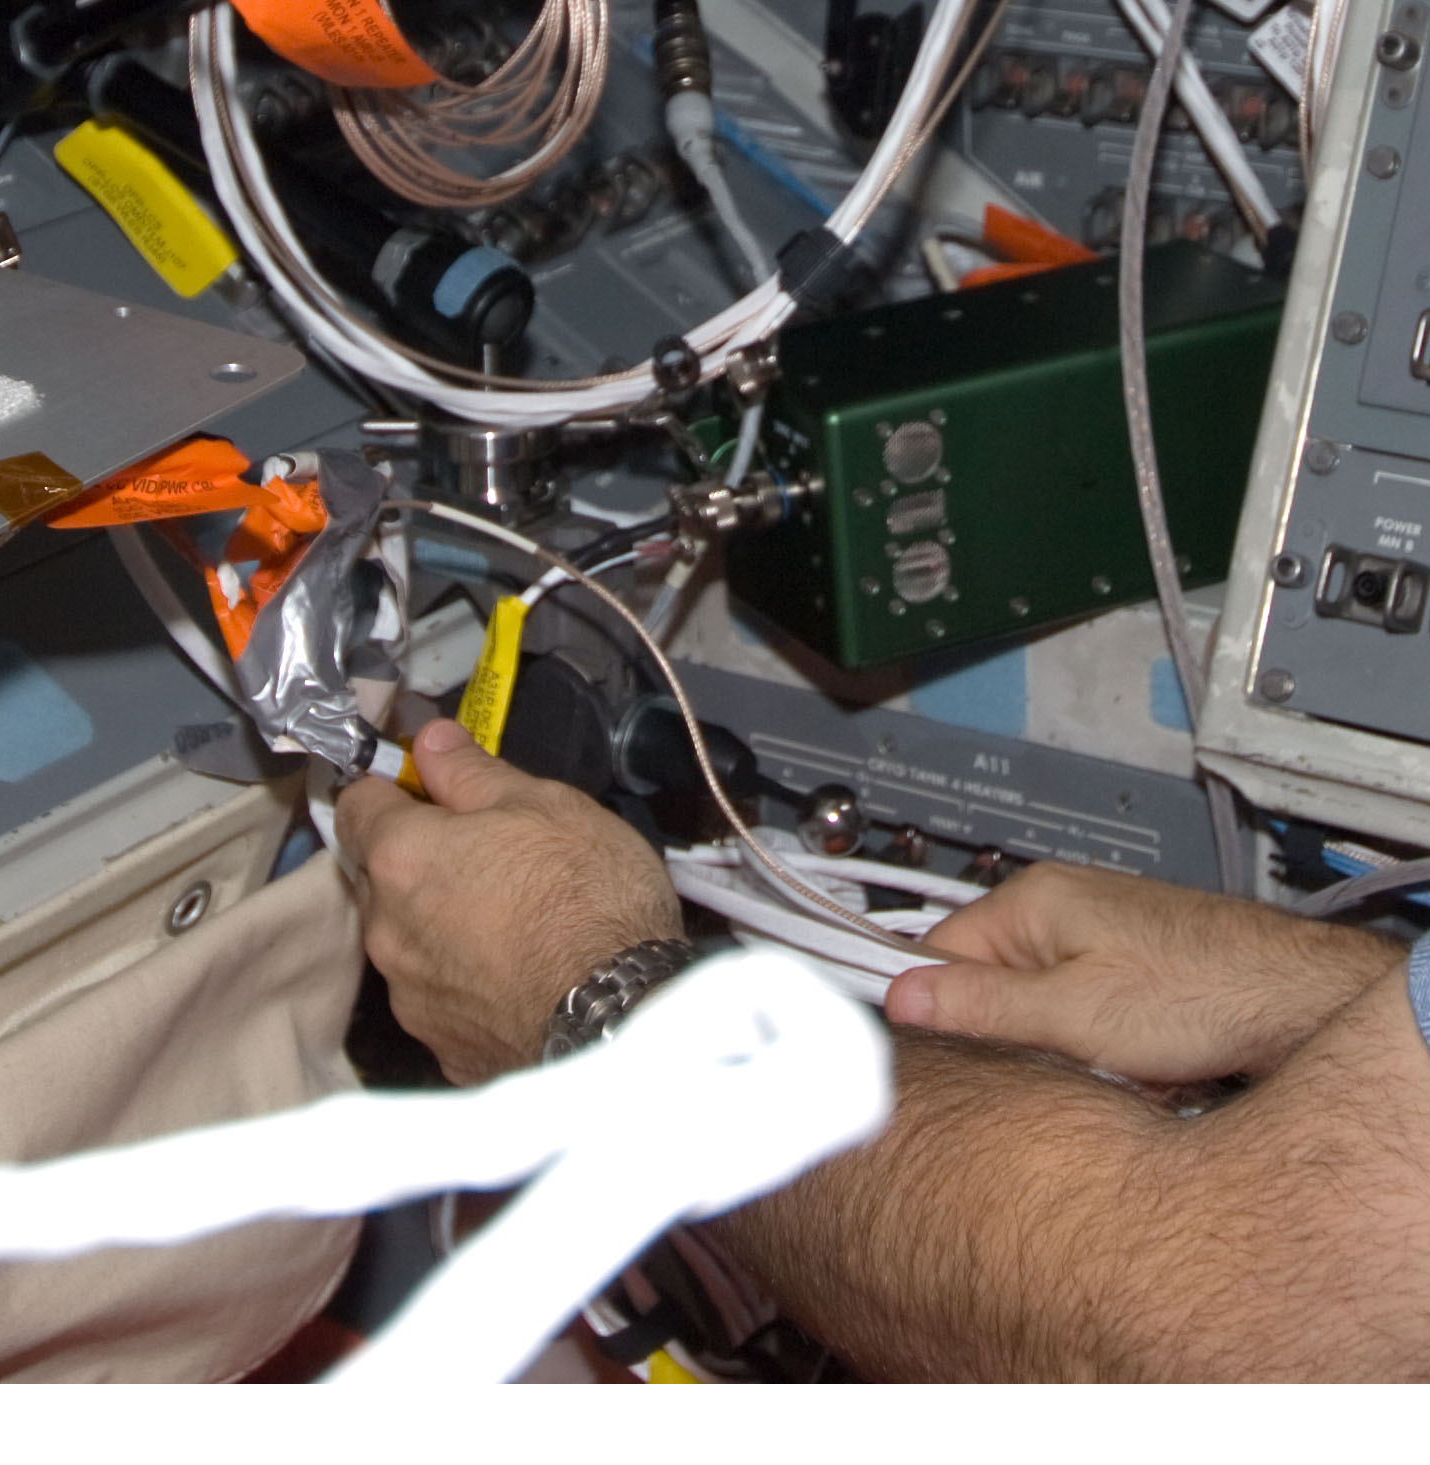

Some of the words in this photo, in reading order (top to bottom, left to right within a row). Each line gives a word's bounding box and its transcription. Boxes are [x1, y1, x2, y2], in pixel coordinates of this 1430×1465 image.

[1374, 515, 1423, 537] POWER
[1377, 533, 1401, 550] MN
[1404, 538, 1415, 554] B
